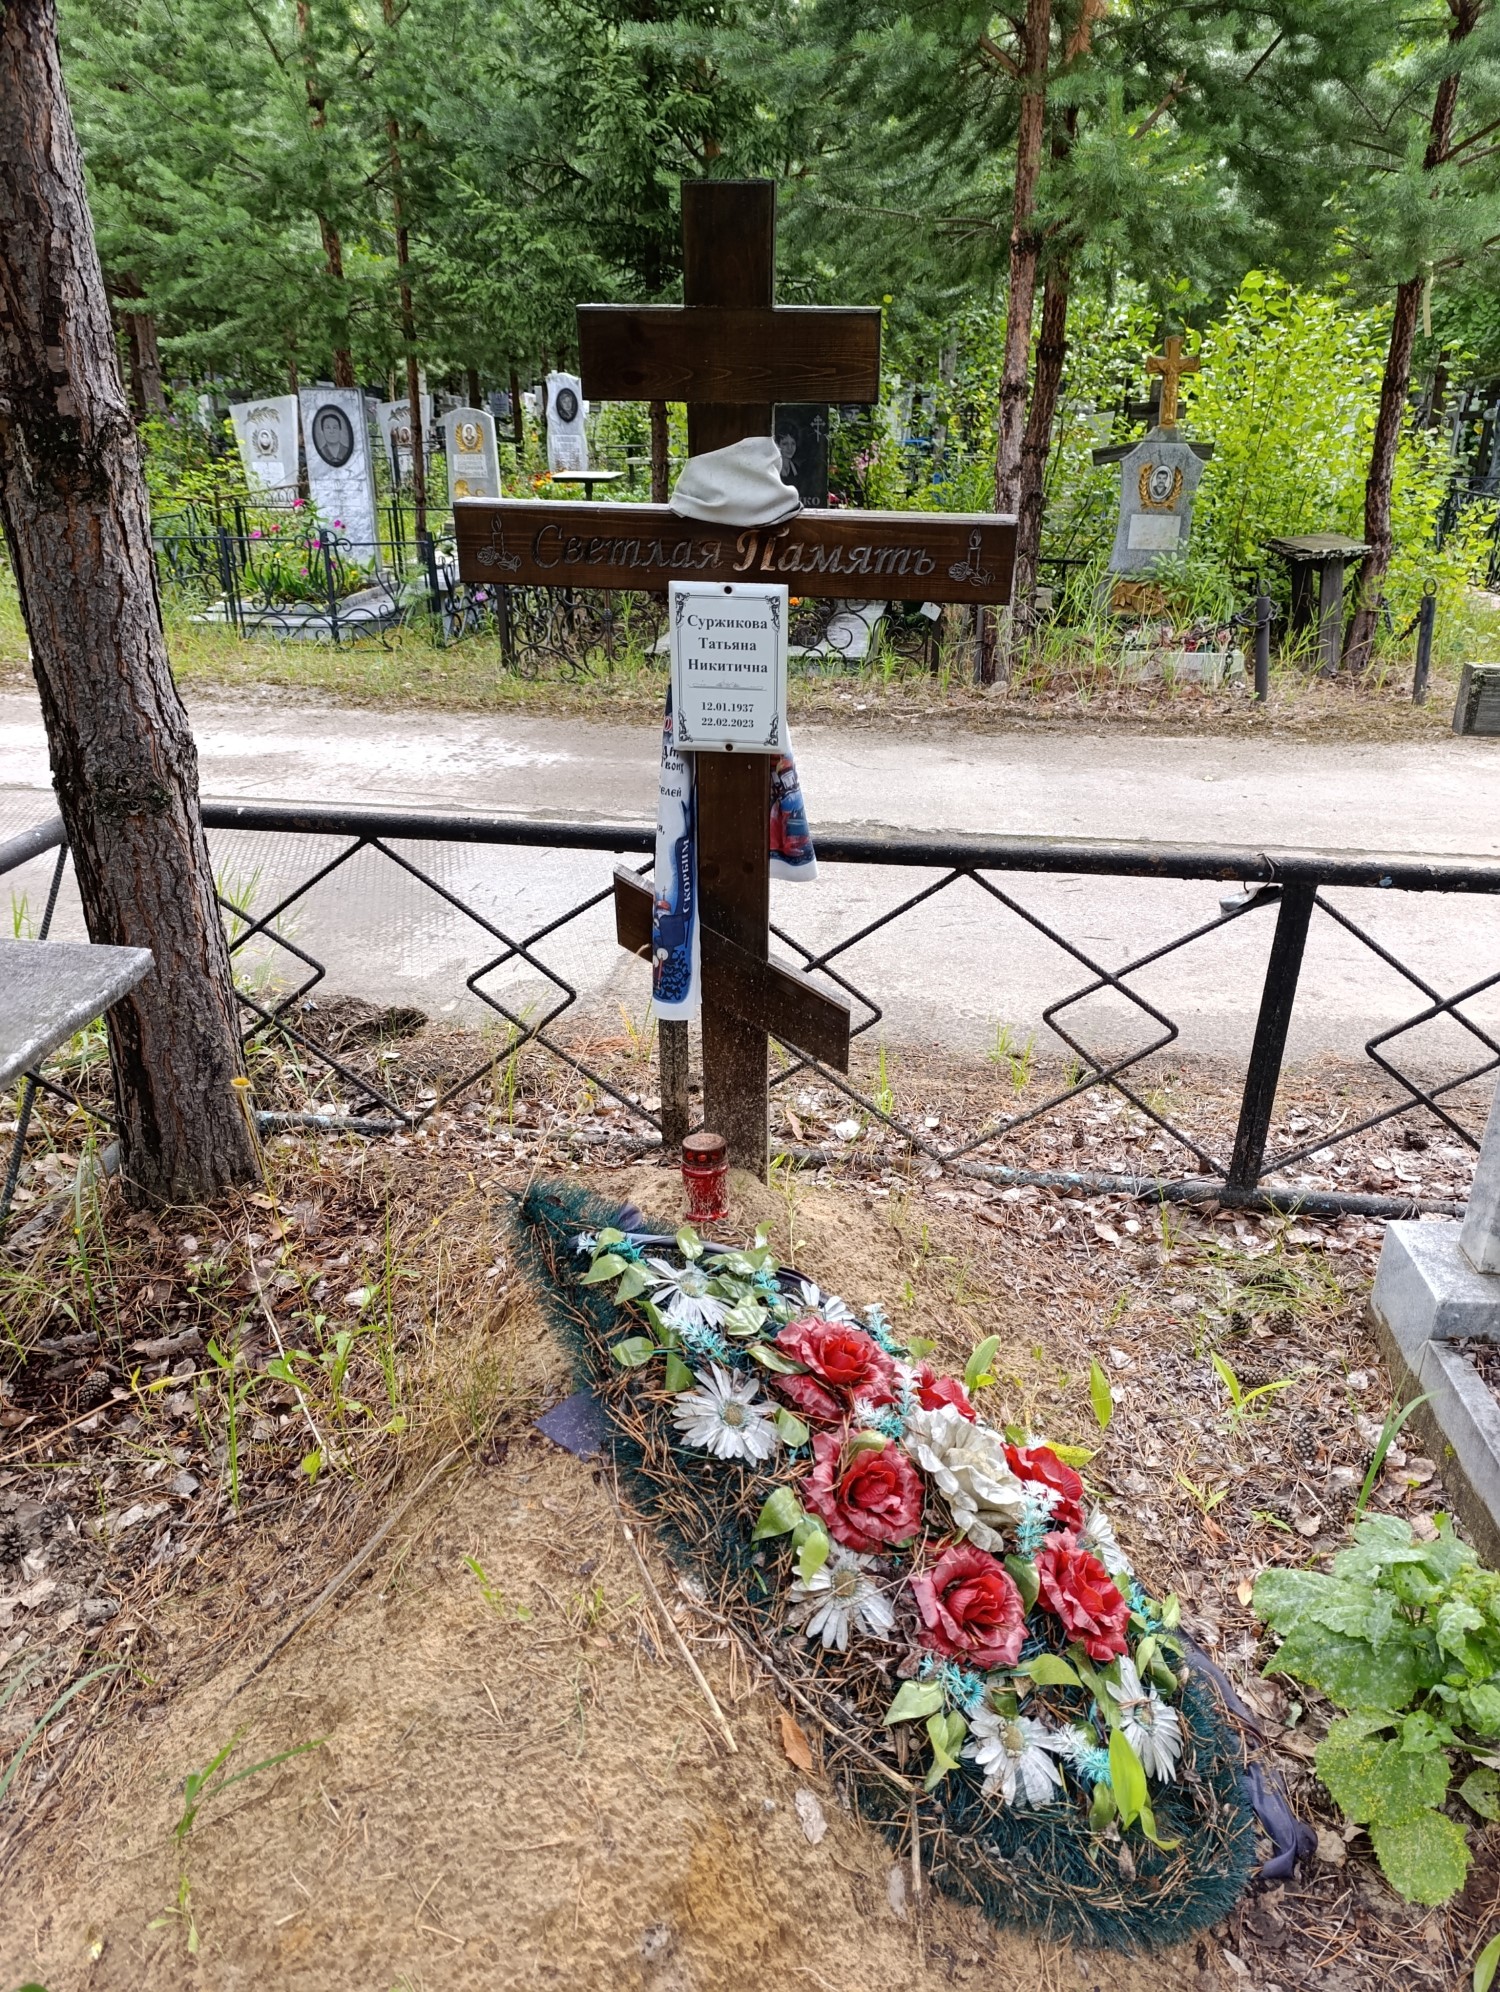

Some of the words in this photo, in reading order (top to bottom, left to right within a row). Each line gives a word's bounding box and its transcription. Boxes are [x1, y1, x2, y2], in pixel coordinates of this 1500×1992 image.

[533, 524, 724, 569] Светлая
[731, 527, 936, 576] Память
[687, 614, 768, 630] Суржикова
[698, 637, 757, 651] Татьяна
[688, 658, 768, 673] Никитична
[701, 701, 754, 713] 12.01.1937
[701, 717, 754, 728] 22.02.2023
